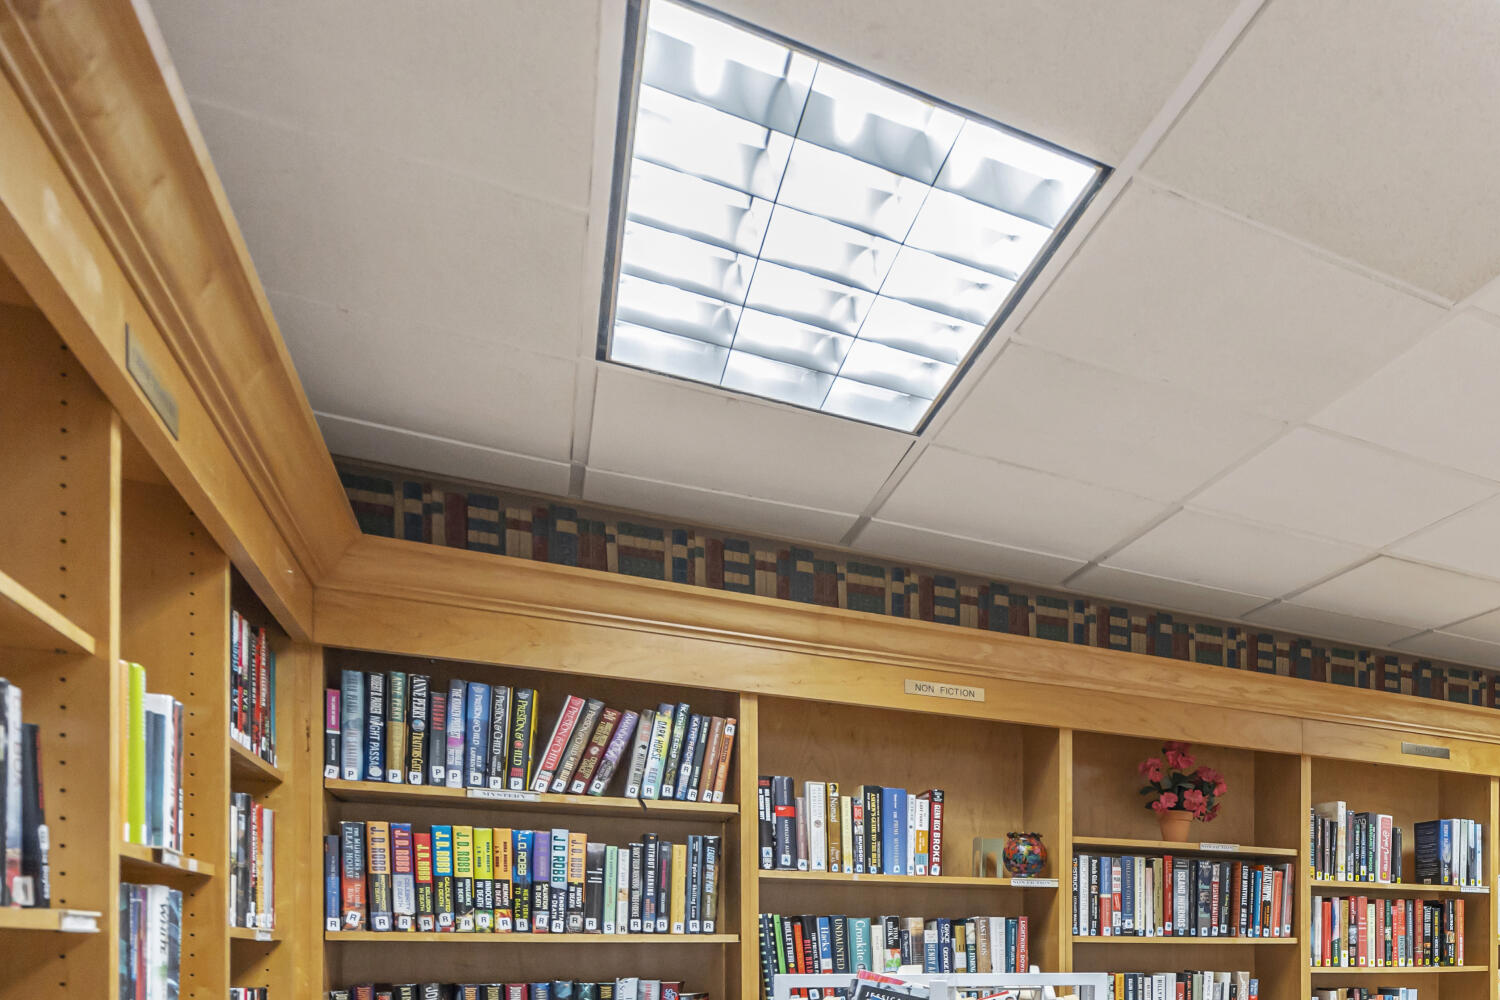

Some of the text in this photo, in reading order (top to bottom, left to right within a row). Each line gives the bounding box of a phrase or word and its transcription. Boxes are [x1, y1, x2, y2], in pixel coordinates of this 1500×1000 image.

[914, 682, 976, 698] NON FICTION
[552, 856, 566, 882] ROBB
[834, 918, 845, 970] UNDAUNTED
[855, 921, 867, 963] Cronkite
